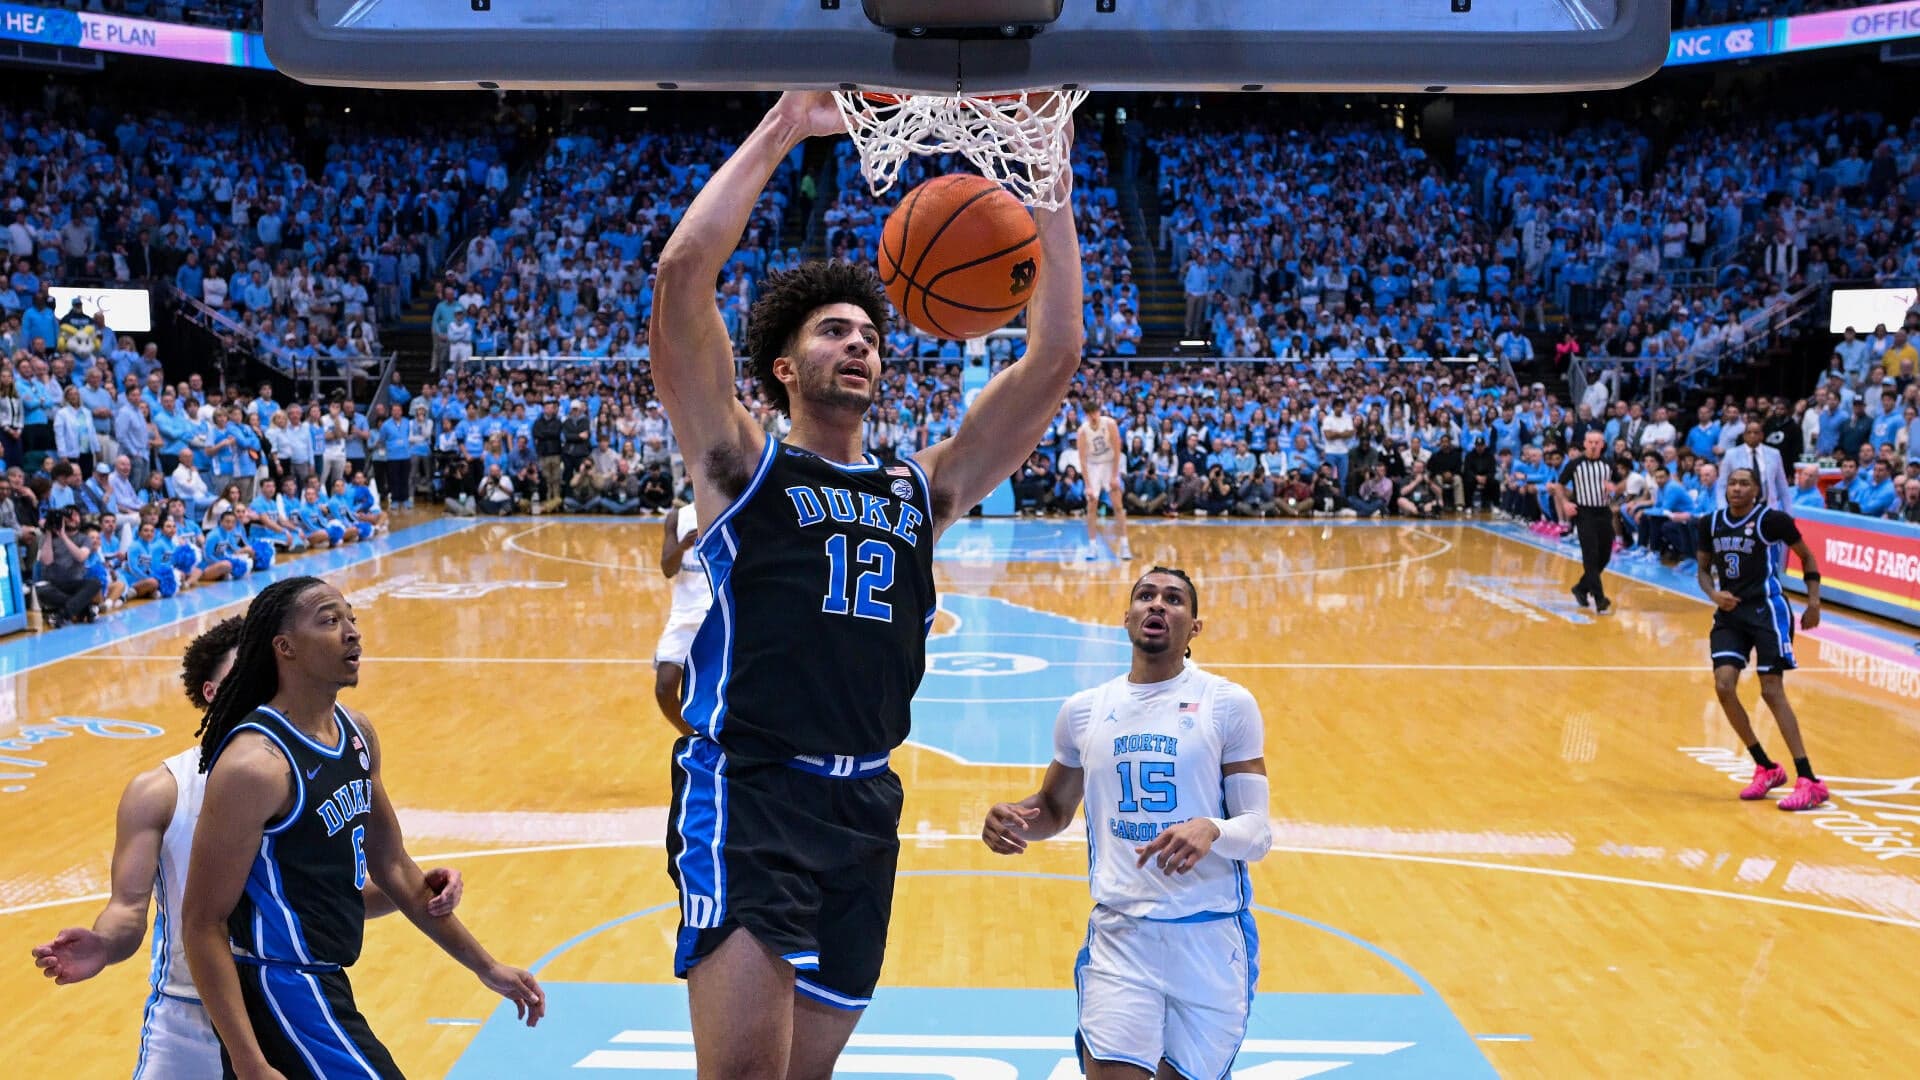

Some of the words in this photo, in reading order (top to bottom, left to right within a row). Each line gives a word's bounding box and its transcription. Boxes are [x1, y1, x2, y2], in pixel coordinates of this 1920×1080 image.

[107, 24, 156, 47] PLAN
[1676, 36, 1711, 57] NC
[785, 486, 923, 548] DUKE
[1713, 536, 1755, 555] DUKE
[1724, 552, 1740, 579] 3
[1825, 538, 1875, 573] WELLS
[1875, 549, 1920, 586] FARG
[822, 533, 896, 621] 12
[1114, 733, 1178, 756] NORTH
[1116, 761, 1178, 813] 15
[1110, 817, 1192, 842] CAROL
[352, 824, 367, 891] 6
